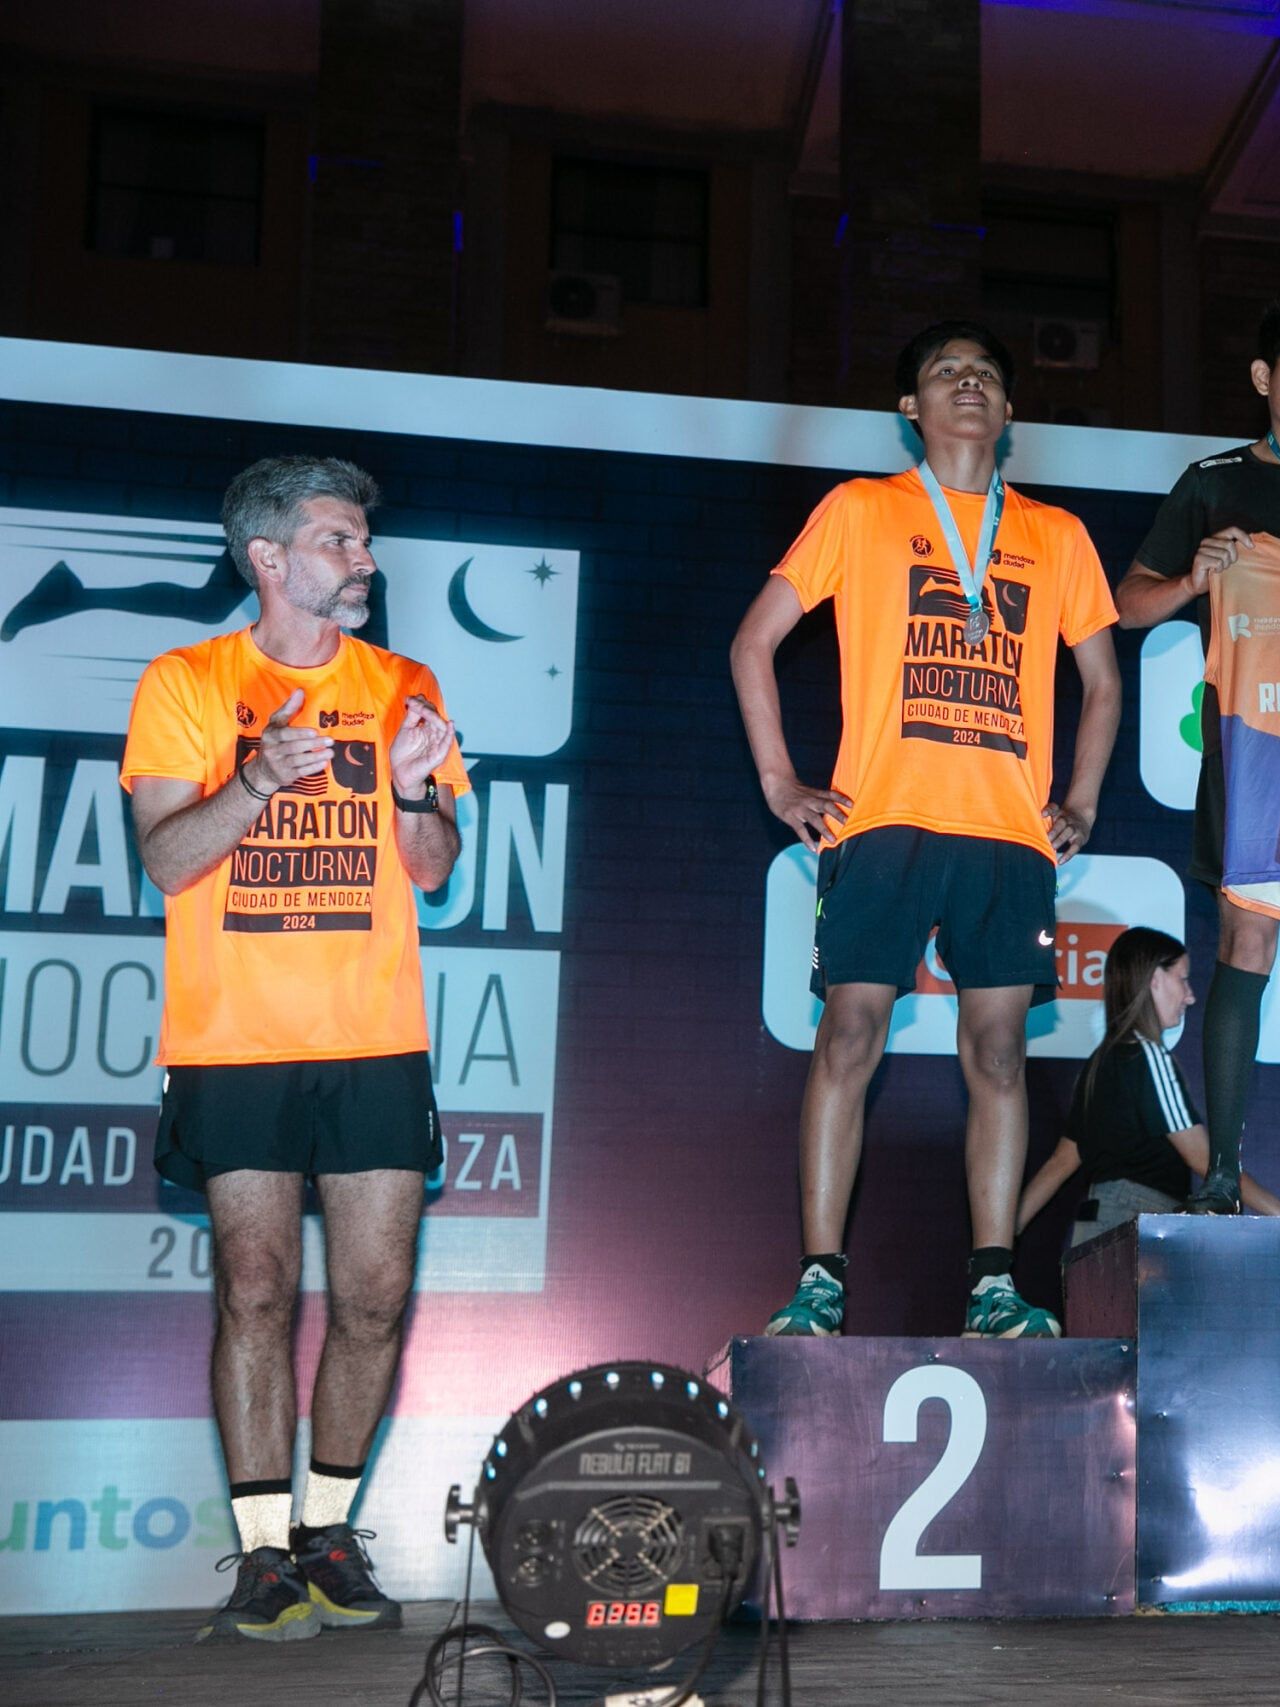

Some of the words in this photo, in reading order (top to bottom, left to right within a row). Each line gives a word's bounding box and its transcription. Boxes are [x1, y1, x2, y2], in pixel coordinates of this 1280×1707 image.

[907, 704, 950, 721] CIUDAD
[954, 709, 969, 723] DE
[953, 729, 981, 745] 2024
[246, 795, 378, 840] ARATÓN
[234, 850, 371, 883] NOCTURNA
[232, 892, 277, 908] CIUDAD
[284, 893, 301, 907] DE
[308, 892, 371, 907] MENDOZA
[283, 915, 316, 930] 2024
[879, 1364, 988, 1590] 2
